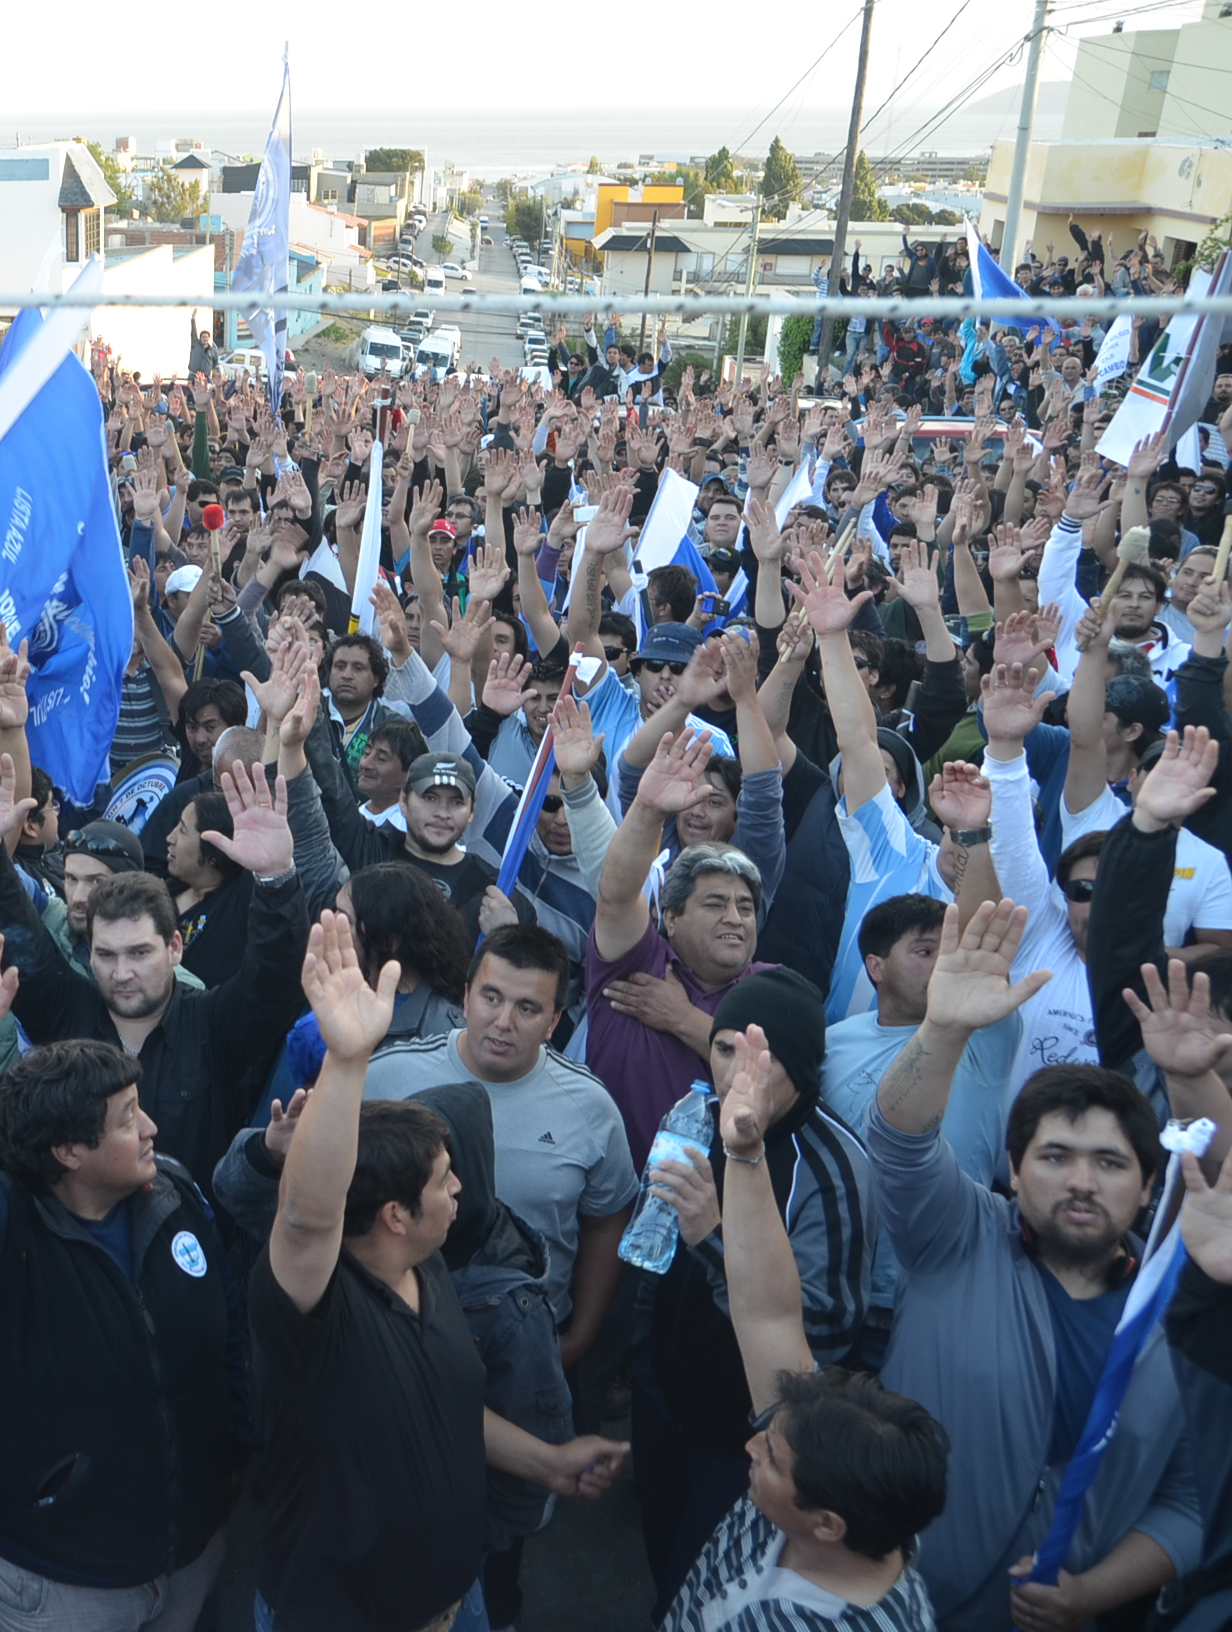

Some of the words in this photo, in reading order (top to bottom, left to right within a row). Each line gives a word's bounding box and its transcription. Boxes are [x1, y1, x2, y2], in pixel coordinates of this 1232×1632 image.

[1099, 360, 1125, 377] CAMBIO
[9, 485, 33, 531] LISTA
[1, 522, 25, 565] AZUL
[125, 787, 136, 799] DE
[137, 780, 167, 793] OCTUBRE
[1062, 1022, 1081, 1036] SINCE
